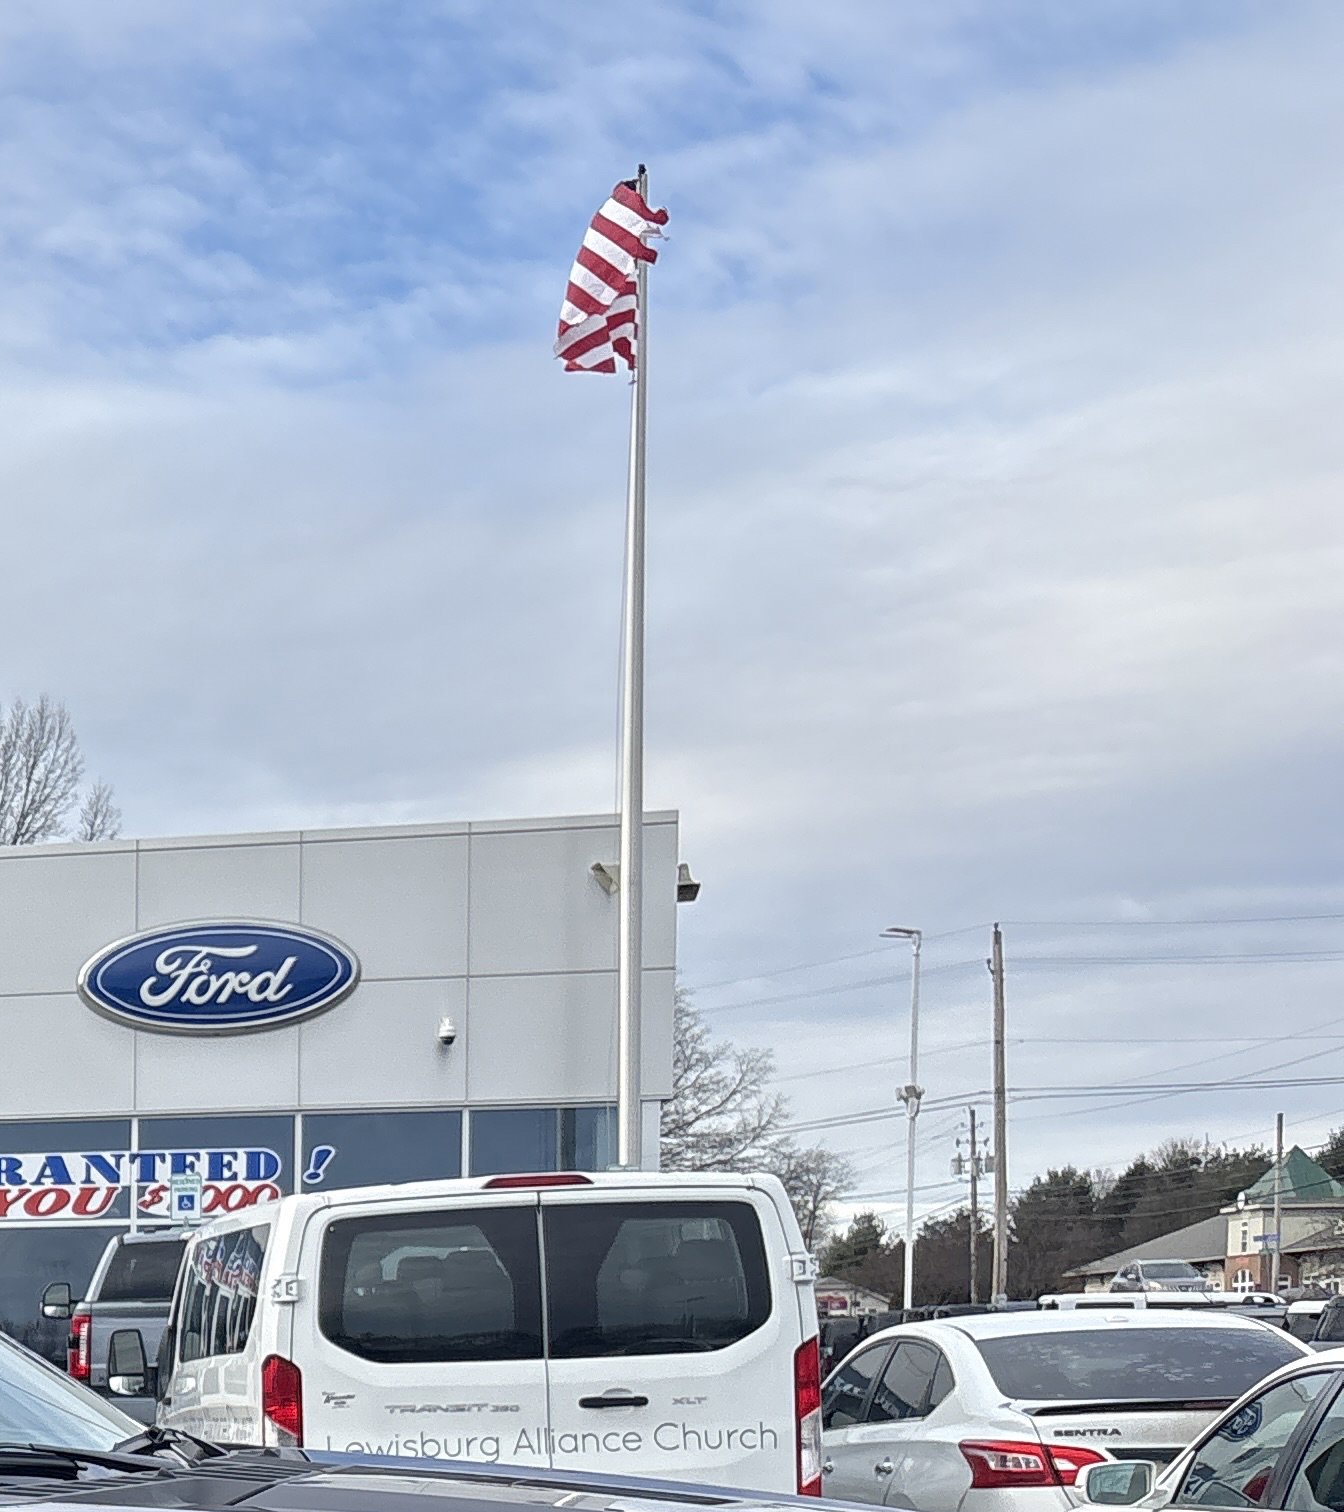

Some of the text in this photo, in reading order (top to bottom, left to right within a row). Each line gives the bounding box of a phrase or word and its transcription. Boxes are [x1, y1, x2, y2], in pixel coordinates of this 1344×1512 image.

[139, 944, 299, 1007] Ford
[383, 1402, 490, 1414] TRANSIT
[513, 1426, 643, 1456] Alliance
[653, 1421, 778, 1451] Church
[1052, 1428, 1123, 1438] SENTRA
